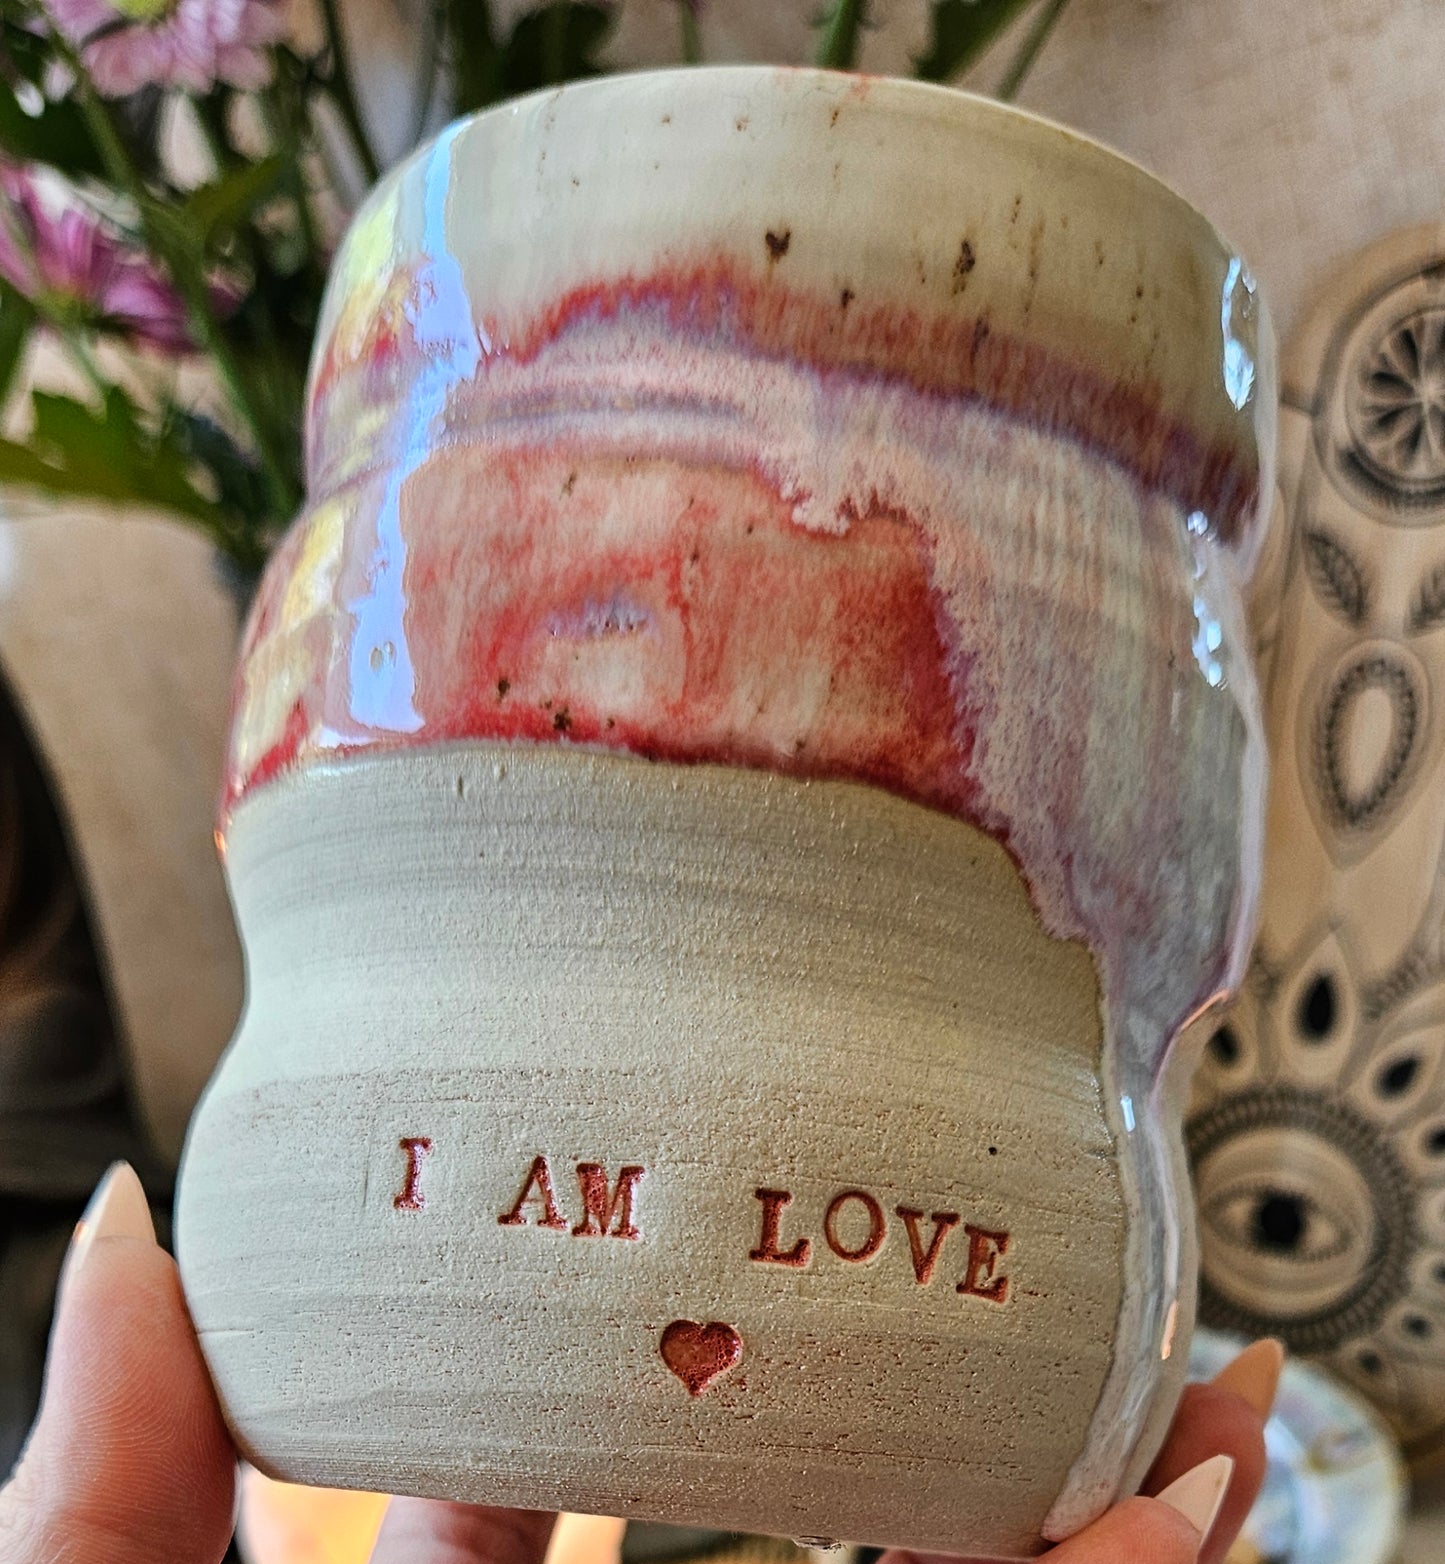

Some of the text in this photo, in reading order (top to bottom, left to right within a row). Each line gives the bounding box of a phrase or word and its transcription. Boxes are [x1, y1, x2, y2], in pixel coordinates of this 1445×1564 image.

[393, 1136, 1011, 1303] I AM LOVE
